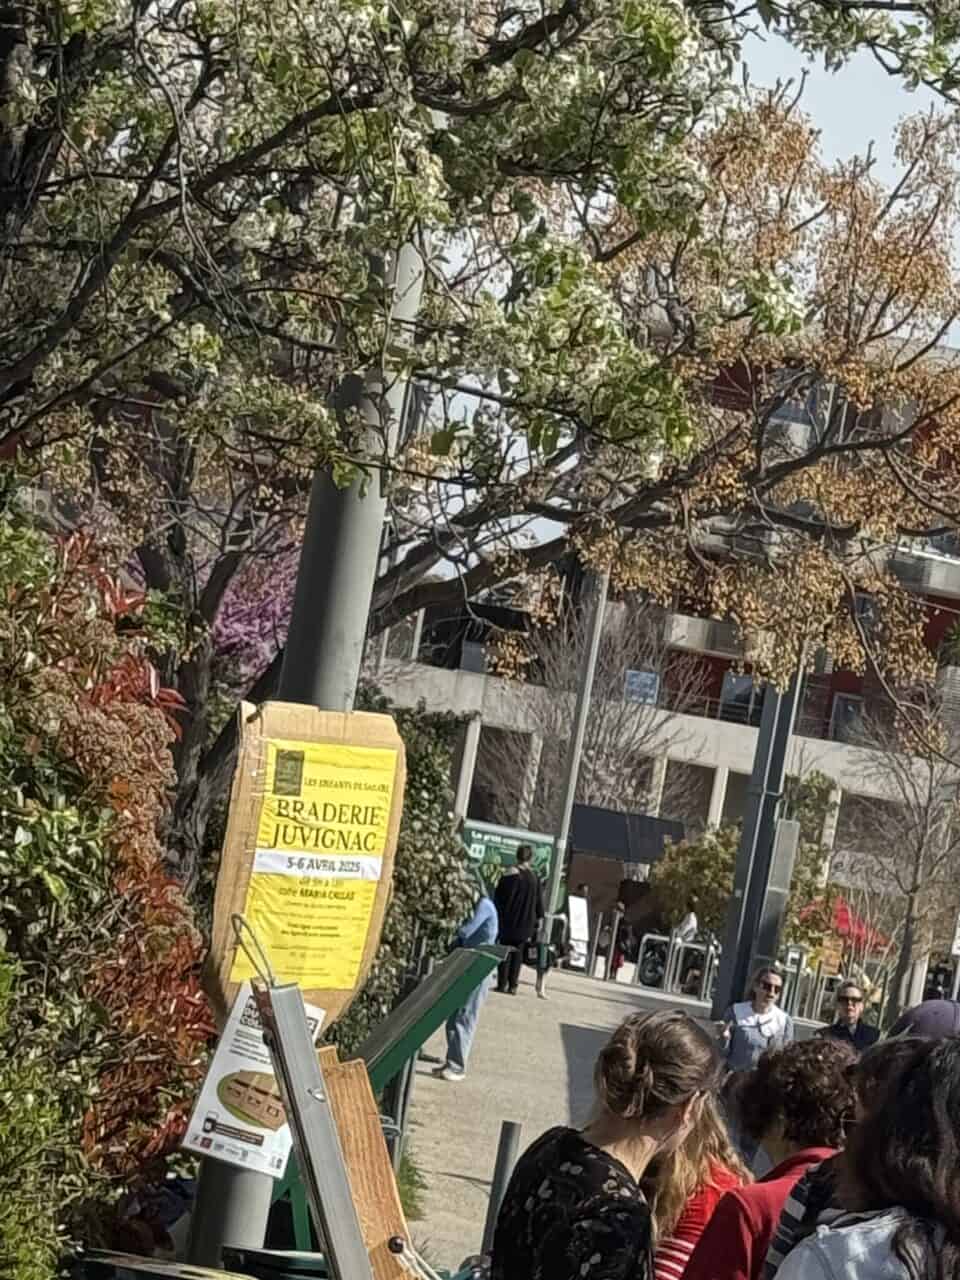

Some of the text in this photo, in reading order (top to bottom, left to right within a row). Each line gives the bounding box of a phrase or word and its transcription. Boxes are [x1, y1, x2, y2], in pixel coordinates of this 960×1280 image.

[276, 799, 382, 826] BRADERIE
[272, 824, 377, 852] JUVIGNAC
[287, 857, 305, 870] 5-6
[306, 858, 336, 872] AVRIL
